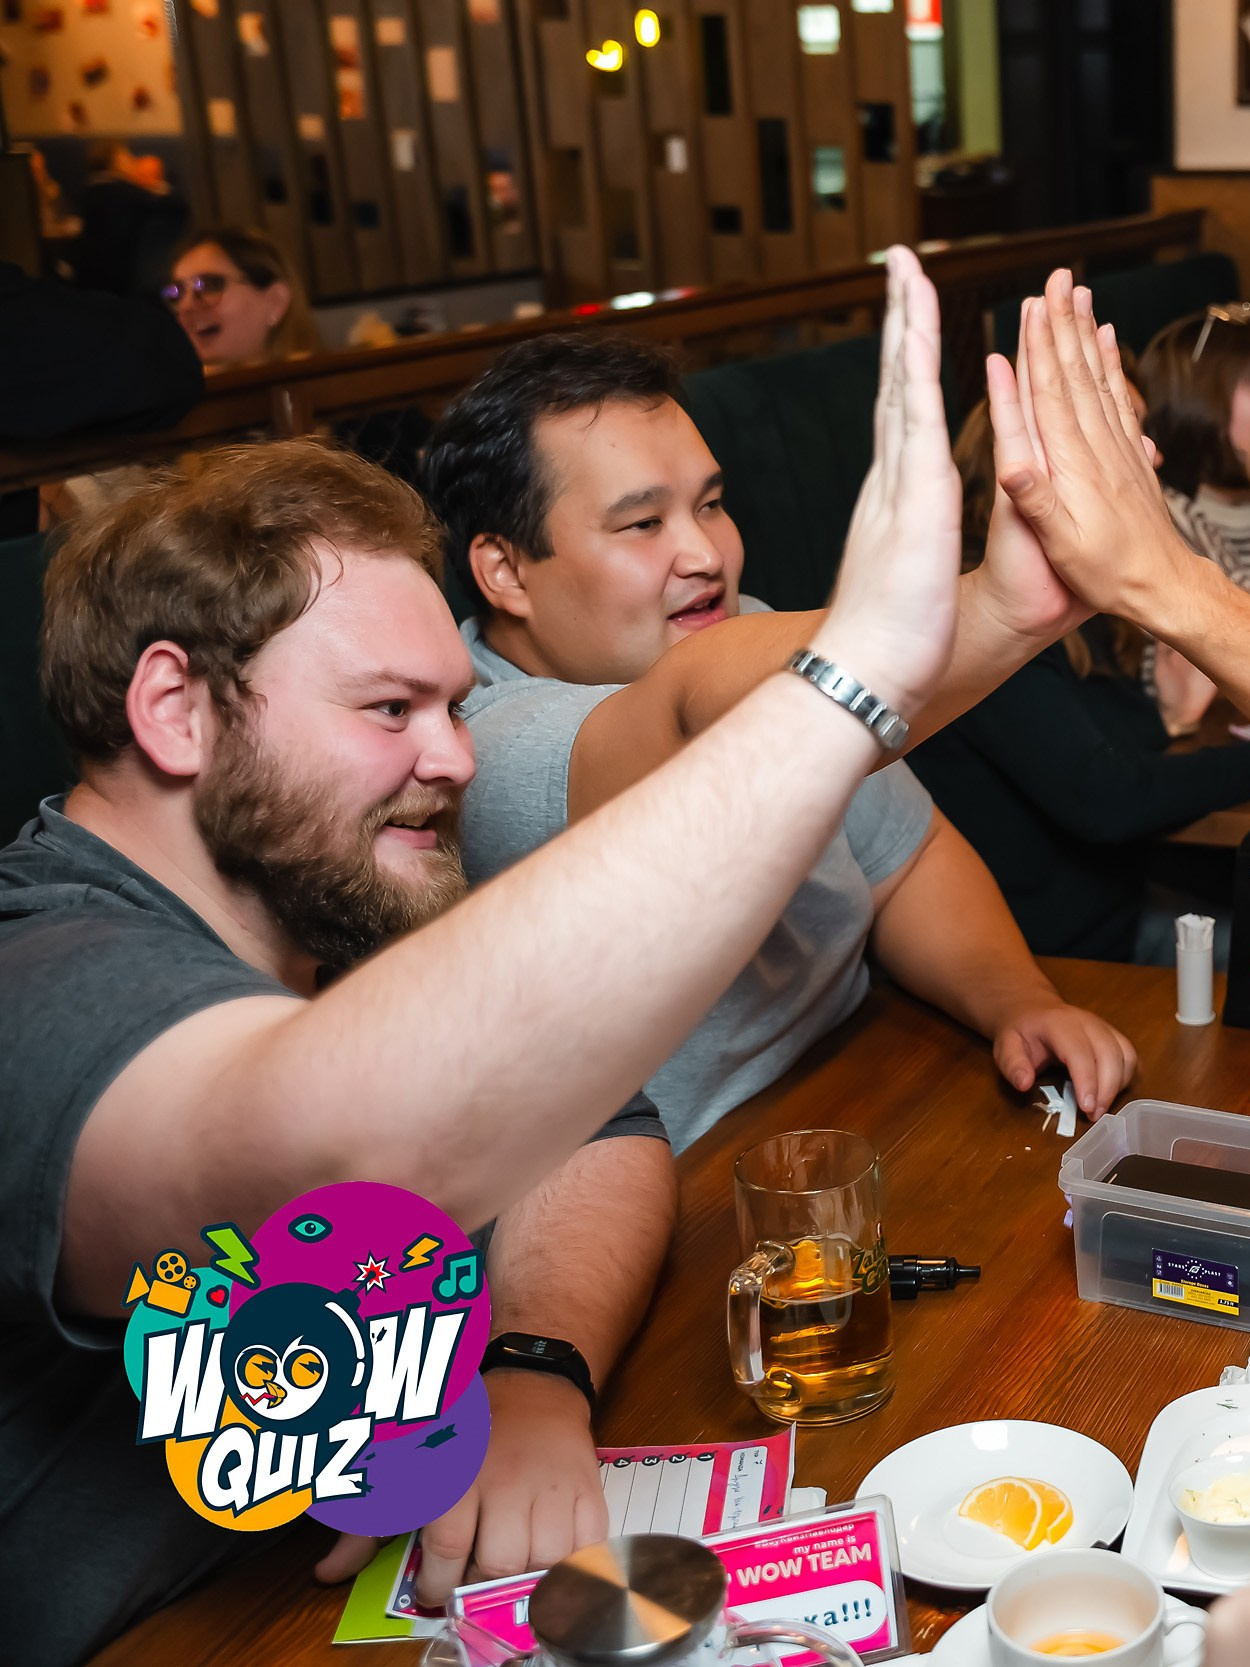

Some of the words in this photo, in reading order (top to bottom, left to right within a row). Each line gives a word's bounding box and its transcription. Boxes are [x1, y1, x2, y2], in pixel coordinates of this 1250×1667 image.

[1204, 1269, 1221, 1277] PLAST
[793, 1544, 811, 1555] my
[813, 1538, 844, 1550] name
[846, 1534, 857, 1544] is
[736, 1556, 803, 1588] WOW
[807, 1543, 872, 1572] TEAM
